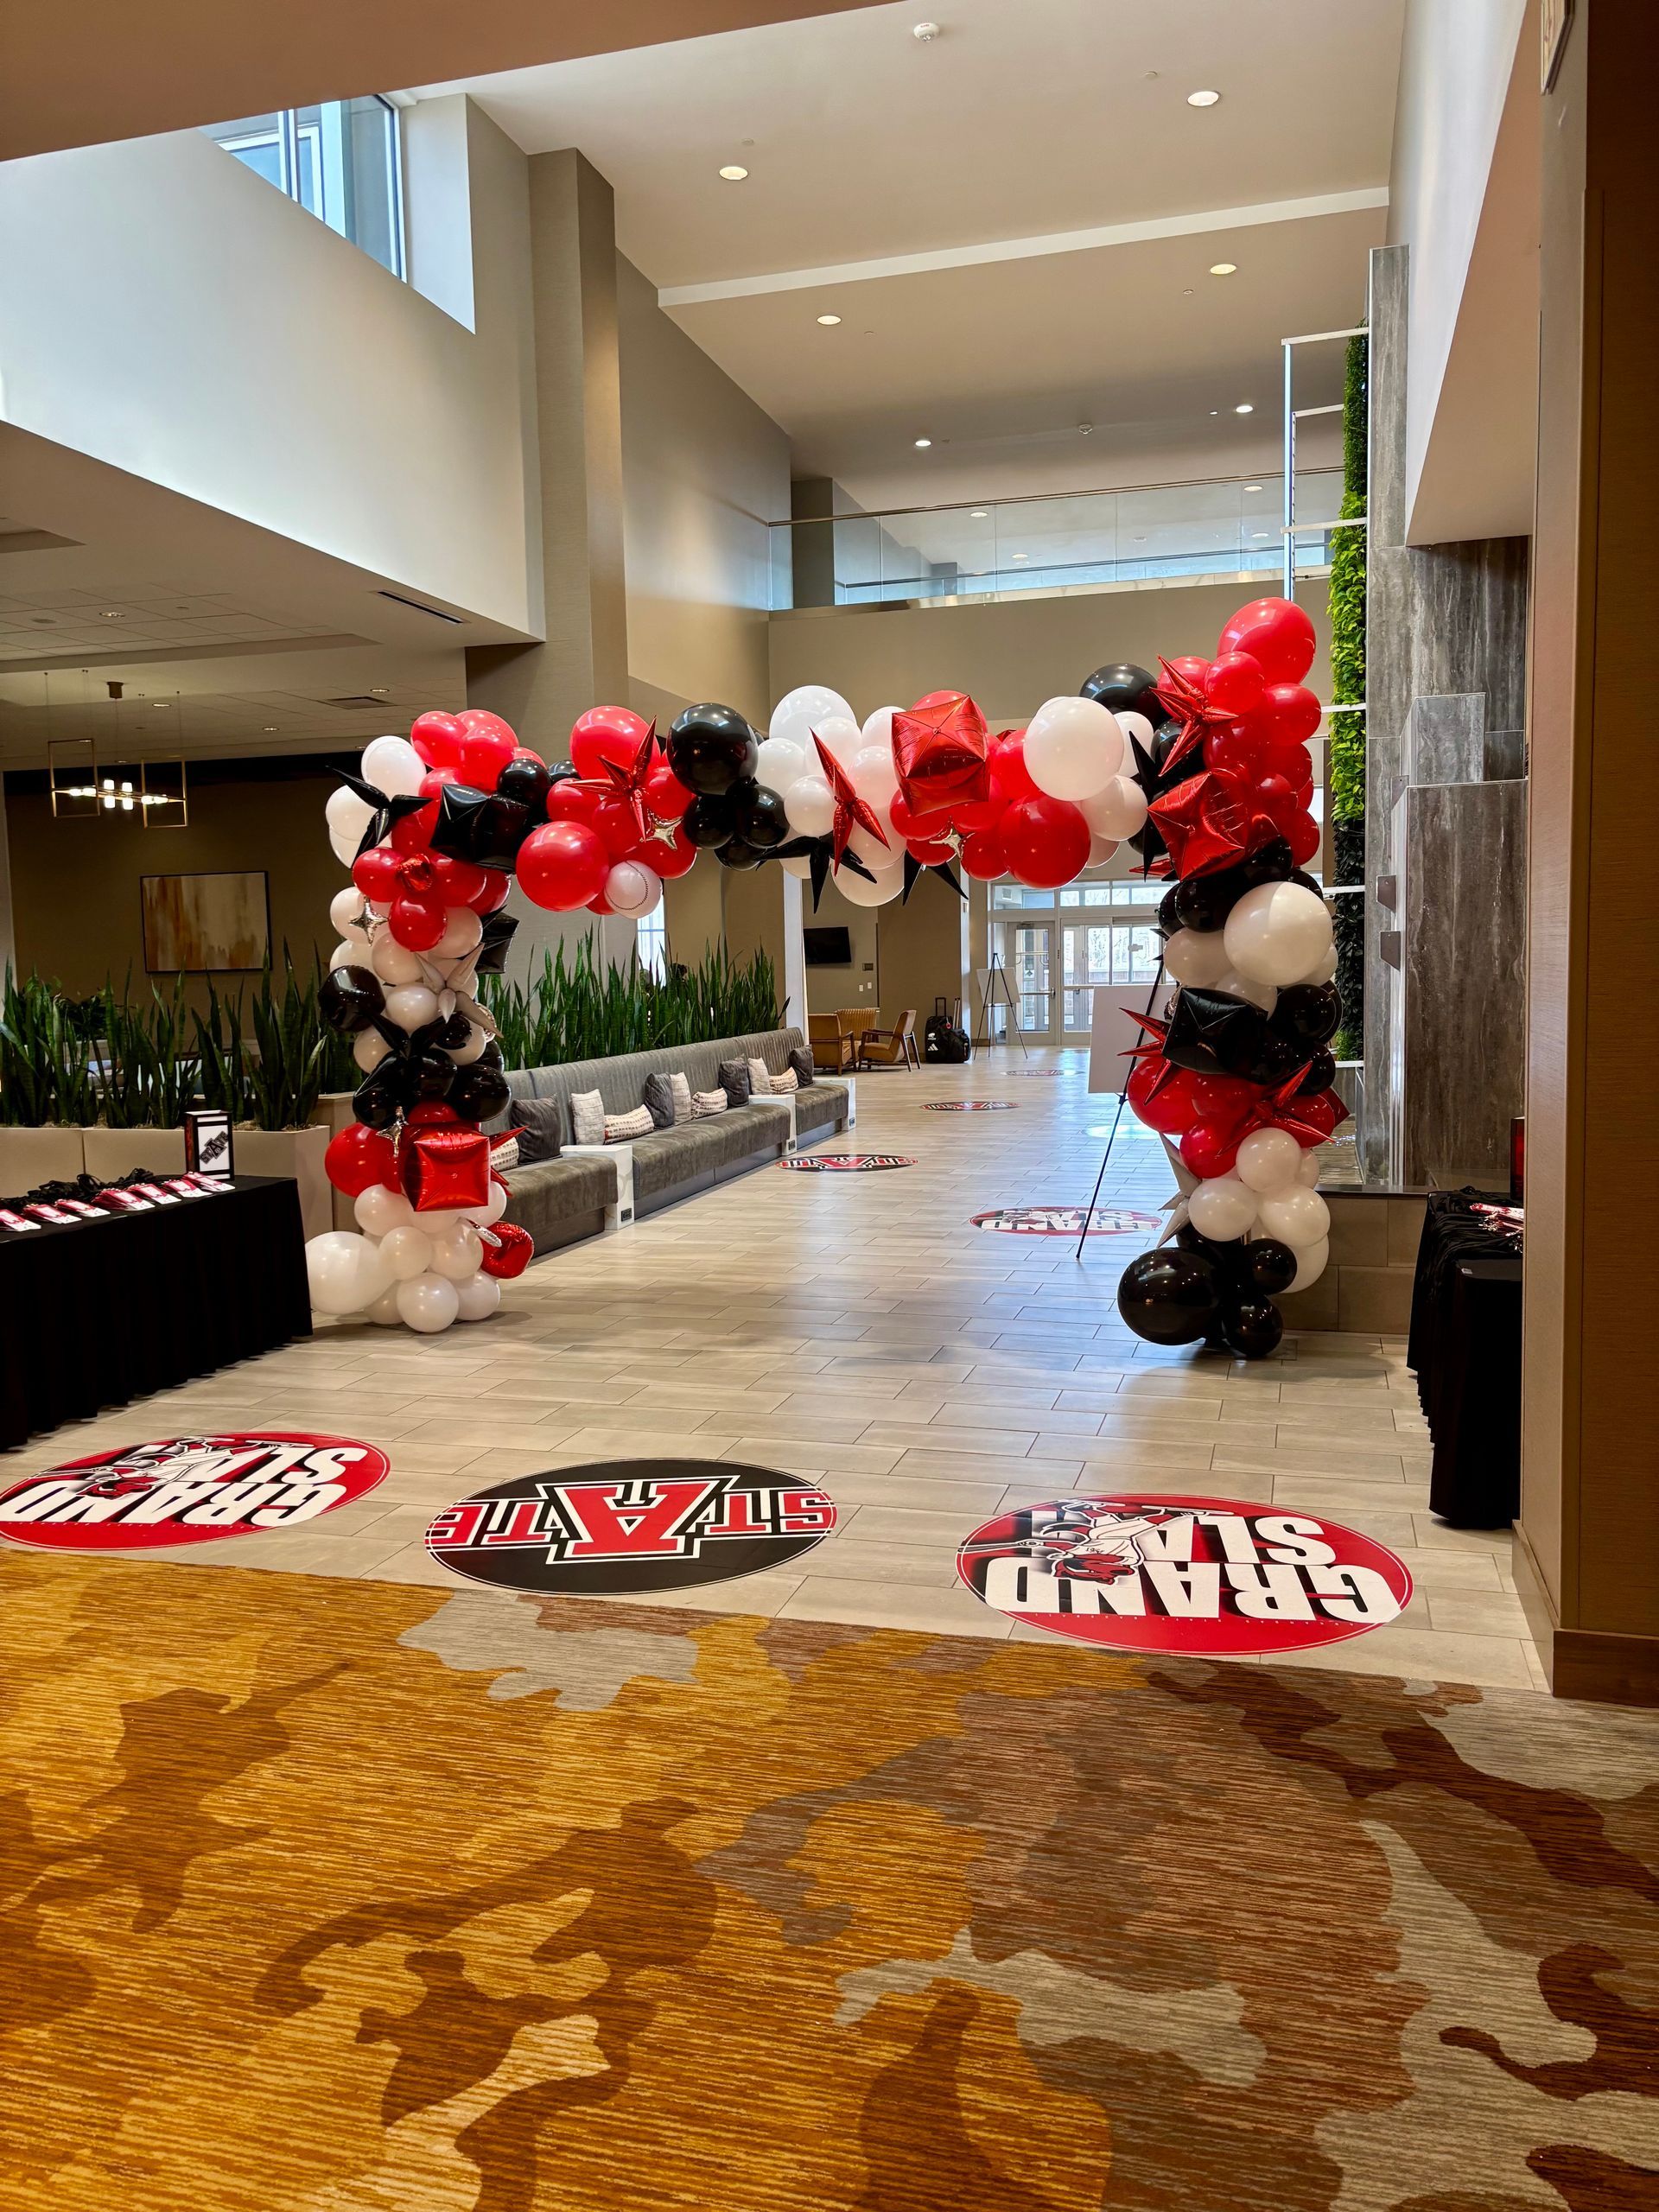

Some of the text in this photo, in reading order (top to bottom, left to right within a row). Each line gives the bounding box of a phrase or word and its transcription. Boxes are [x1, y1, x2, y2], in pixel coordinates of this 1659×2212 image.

[199, 1130, 229, 1165] STATE
[1002, 1211, 1135, 1221] SLA
[0, 1480, 346, 1528] GRAND
[424, 1476, 836, 1564] STATE
[985, 1556, 1402, 1623] GRAND
